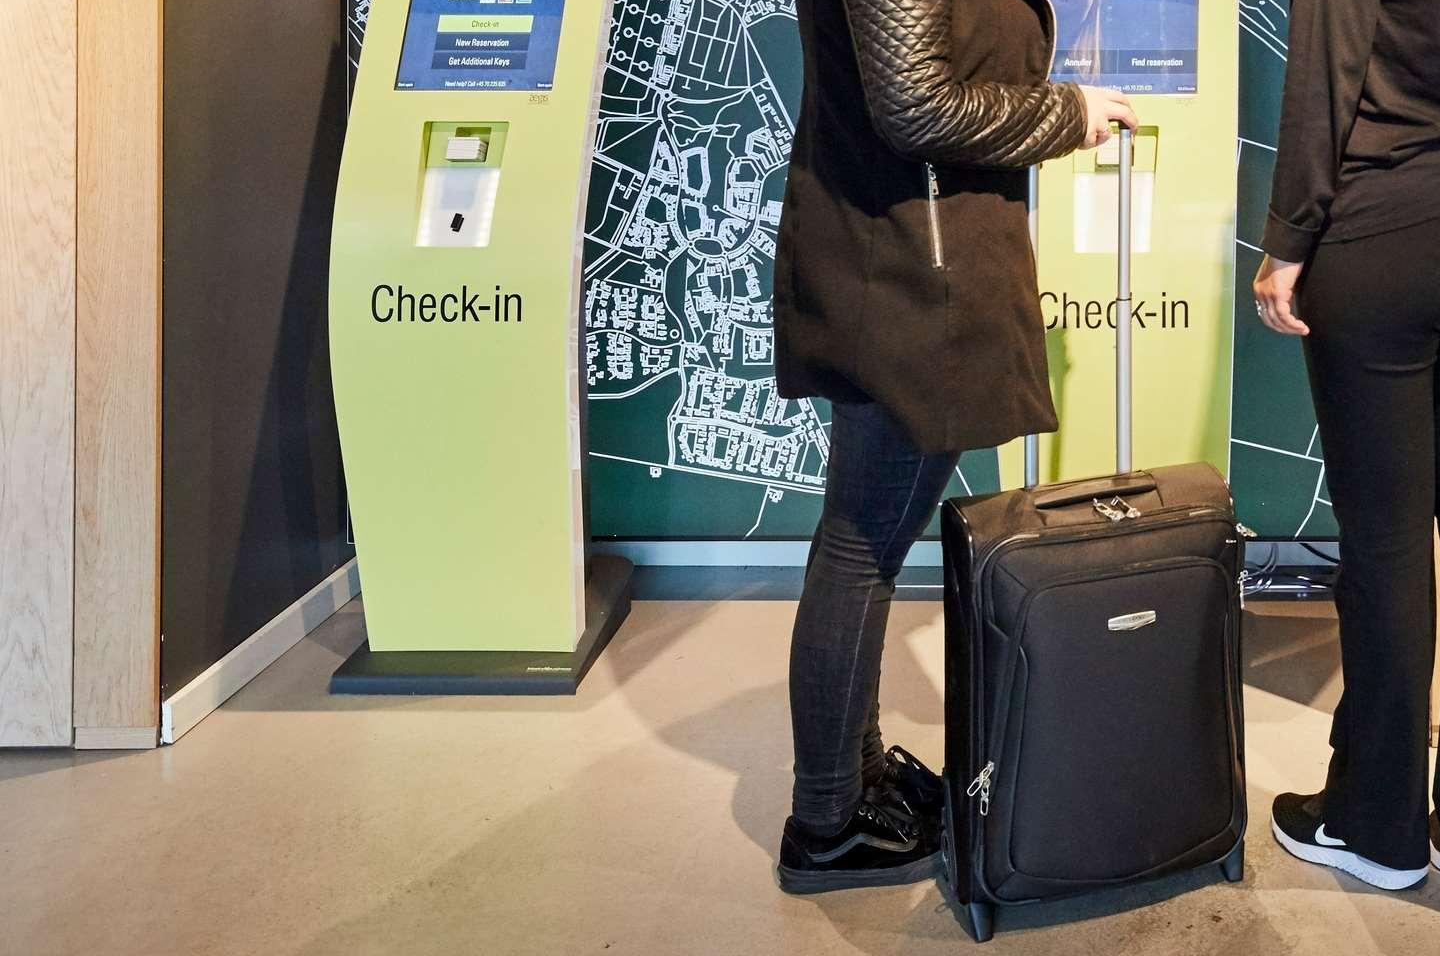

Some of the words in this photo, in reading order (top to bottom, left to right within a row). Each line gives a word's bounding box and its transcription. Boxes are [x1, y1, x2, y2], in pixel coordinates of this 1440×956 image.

[455, 38, 471, 47] New
[472, 38, 510, 47] Reservation
[448, 57, 461, 66] Get
[462, 57, 493, 66] Additional
[494, 57, 510, 67] Keys
[1131, 57, 1145, 66] Find
[1146, 57, 1183, 66] reservation
[371, 284, 523, 323] Check-in
[1040, 292, 1189, 329] Check-in
